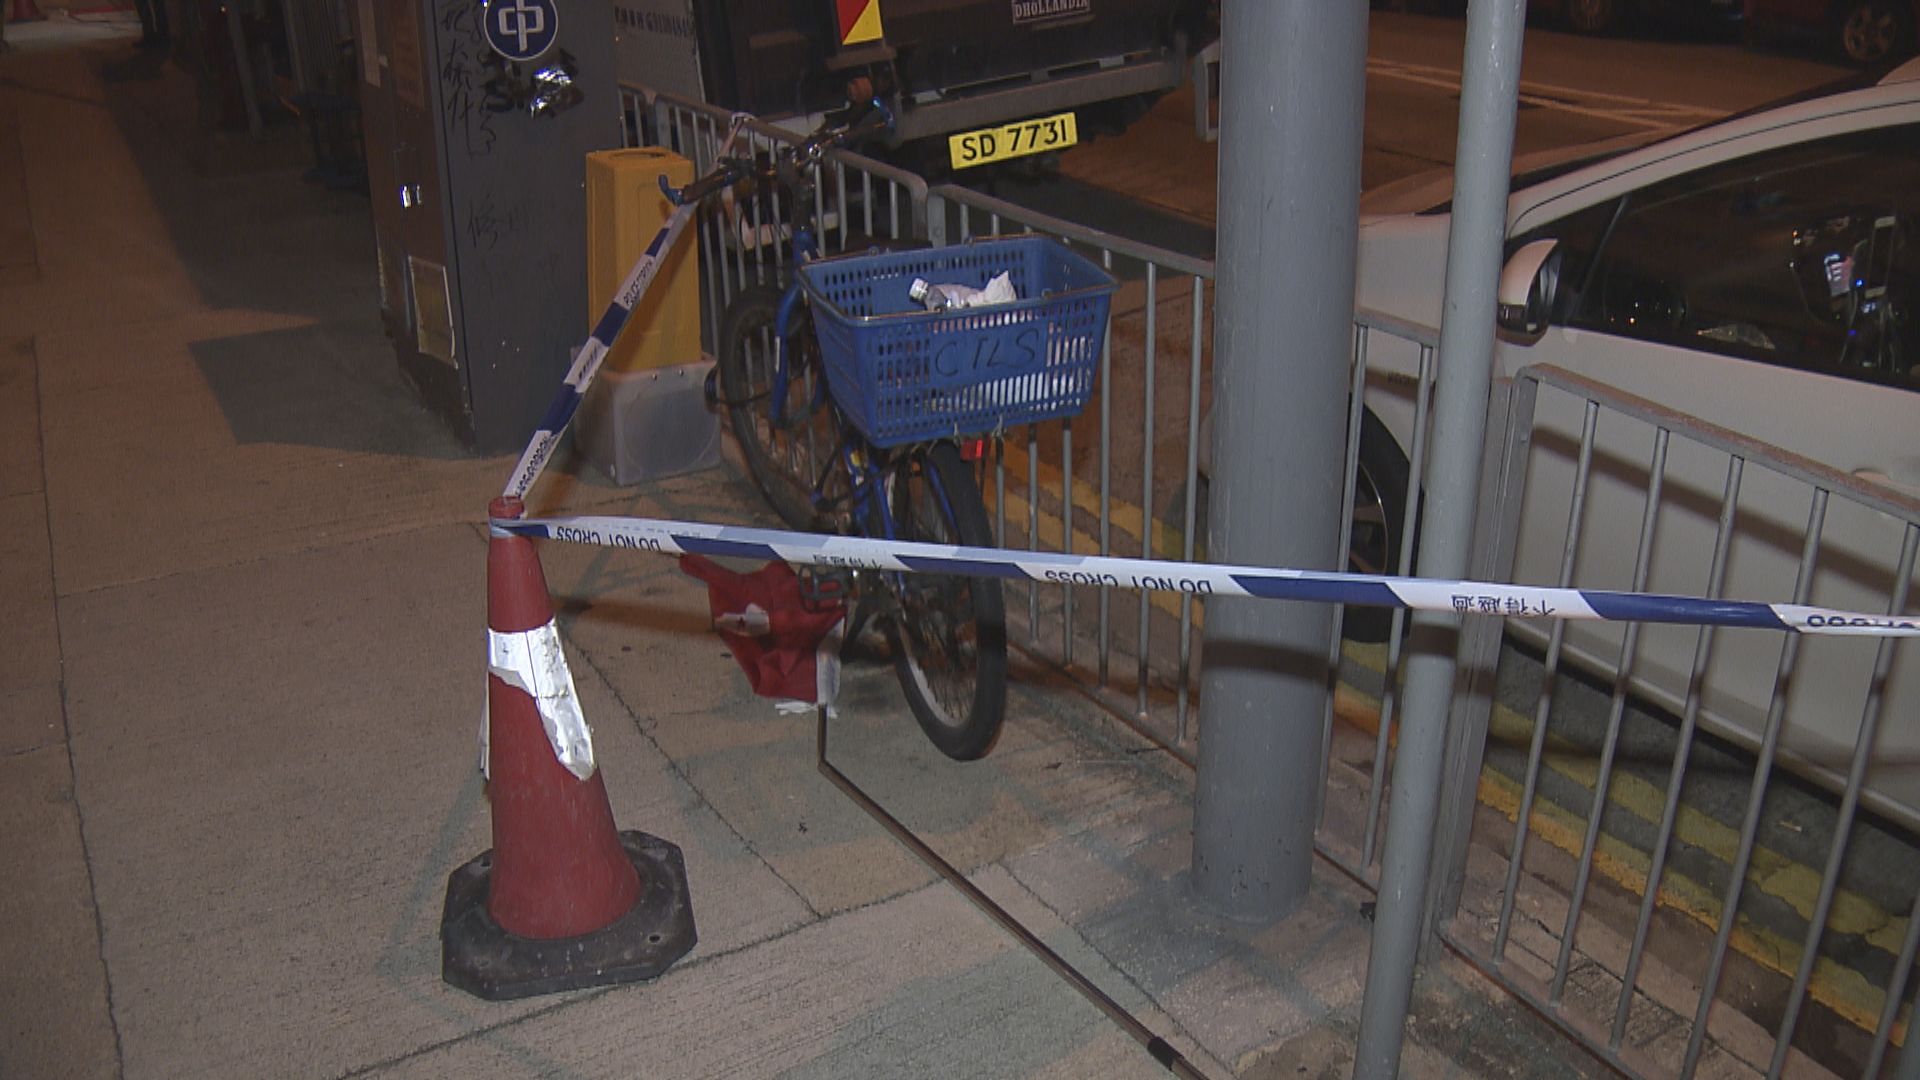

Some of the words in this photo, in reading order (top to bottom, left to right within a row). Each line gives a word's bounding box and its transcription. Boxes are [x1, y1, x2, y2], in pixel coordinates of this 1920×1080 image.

[962, 134, 996, 161] SD
[1007, 119, 1067, 152] 7731
[556, 526, 601, 546] CROSS
[610, 533, 637, 549] NOT
[638, 537, 662, 551] DO
[1045, 570, 1118, 587] CROSS
[1131, 575, 1174, 592] NOT
[1179, 579, 1213, 593] DO
